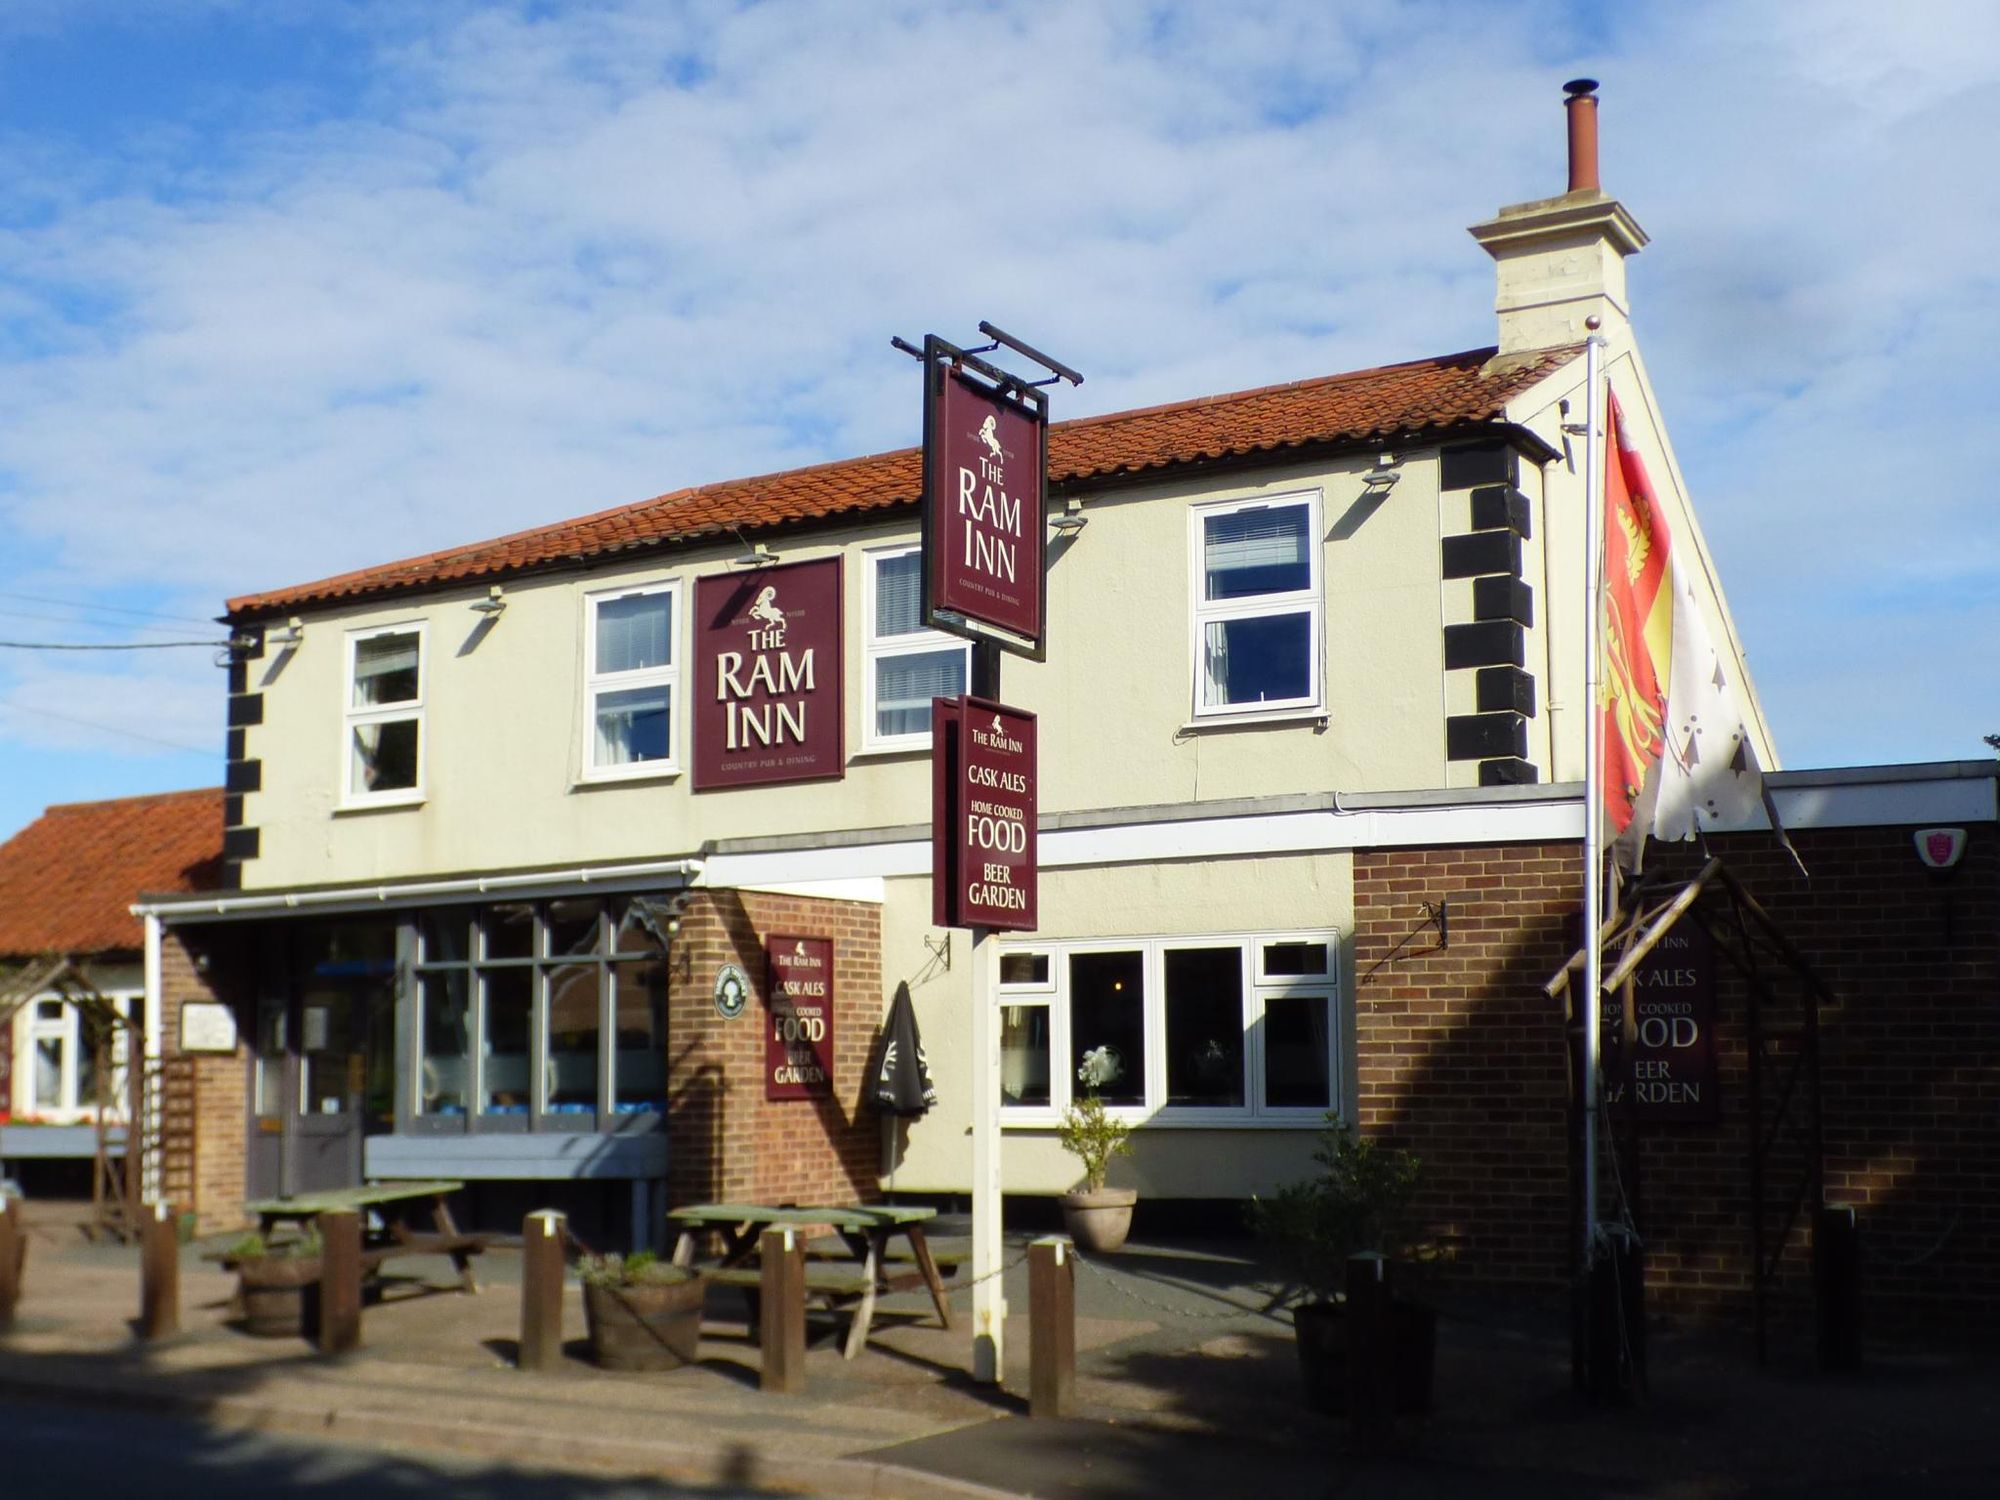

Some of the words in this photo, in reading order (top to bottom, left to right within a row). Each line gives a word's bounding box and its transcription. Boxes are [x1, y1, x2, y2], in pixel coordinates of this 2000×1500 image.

[979, 456, 1004, 486] THE
[959, 466, 1021, 538] RAM
[965, 519, 1015, 584] INN
[959, 577, 984, 593] COUNTRY
[985, 587, 995, 597] PUB
[1001, 594, 1020, 606] DINING
[747, 629, 786, 651] THE
[717, 648, 815, 700] RAM
[726, 701, 805, 749] INN
[972, 729, 988, 745] THE
[990, 733, 1007, 750] RAM
[1009, 738, 1023, 753] INN
[721, 761, 757, 772] COUNTRY
[760, 759, 775, 768] PUB
[786, 755, 816, 765] DINING
[968, 765, 998, 788] CASK
[1000, 772, 1026, 793] ALES
[971, 800, 992, 815] HOME
[994, 804, 1023, 820] COOKED
[968, 814, 1026, 853] FOOD
[984, 863, 1011, 884] BEER
[969, 883, 1025, 910] GARDEN
[1664, 936, 1689, 948] INN
[779, 955, 792, 966] THE
[775, 981, 800, 995] CASK
[802, 982, 825, 997] ALES
[1649, 969, 1697, 987] ALES
[1638, 1003, 1692, 1015] COOKED
[775, 1017, 825, 1042] FOOD
[774, 1066, 824, 1084] GARDEN
[1635, 1061, 1671, 1079] EER
